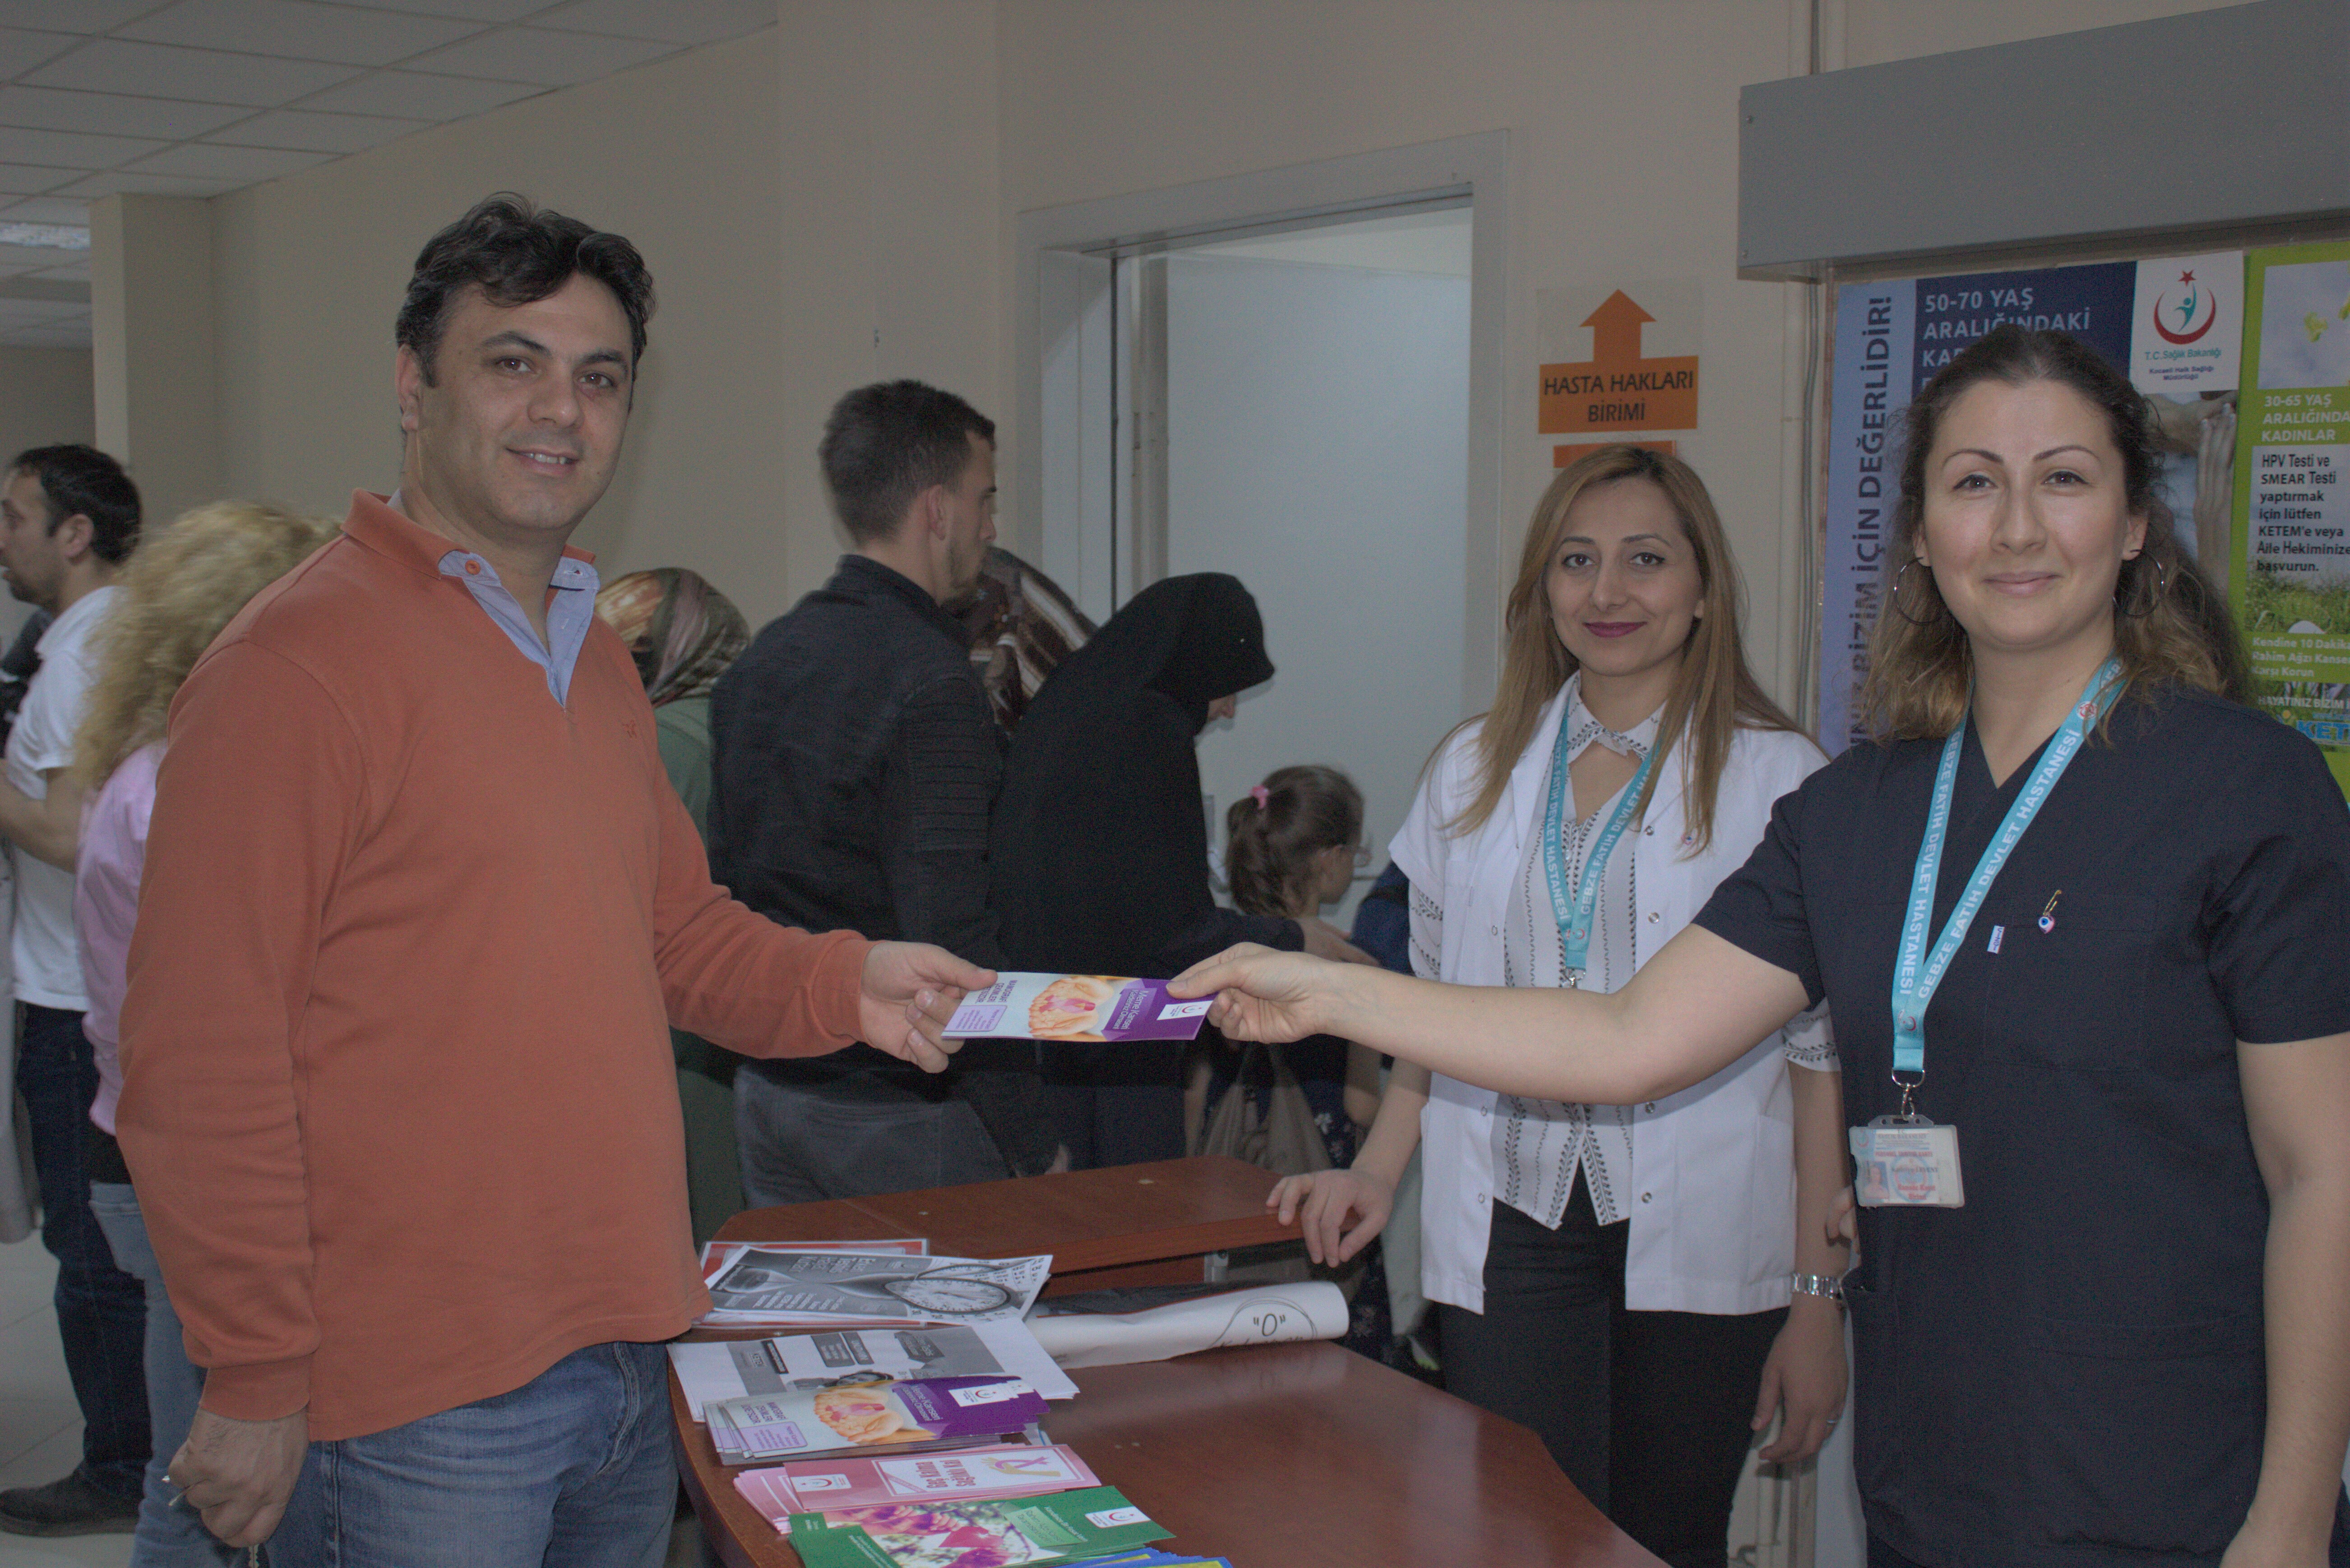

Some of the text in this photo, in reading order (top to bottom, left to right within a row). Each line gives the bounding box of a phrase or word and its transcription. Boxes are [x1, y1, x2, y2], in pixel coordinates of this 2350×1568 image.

[1924, 287, 2035, 313] 50-70 YAŞ
[1543, 370, 1694, 395] HASTA HAKLARI
[1856, 296, 1892, 498] DEĞERLİDİR!
[2264, 393, 2332, 408] 30-65 YAŞ
[1587, 398, 1646, 423] BİRİMİ
[2261, 429, 2336, 442] KADINLAR
[2262, 453, 2330, 468] HPV Testi ve
[2261, 470, 2336, 485] SMEAR Testi
[2259, 489, 2324, 505] yaptırmak
[2258, 507, 2322, 522] için lütfen
[1850, 507, 1885, 572] İÇİN
[2258, 526, 2344, 540] KETEM'e veya
[2256, 540, 2281, 554] Aile
[2256, 559, 2319, 574] başvurun.
[2252, 636, 2298, 648] Kendine
[2300, 638, 2314, 649] 10
[2252, 650, 2286, 662] Rahim
[2287, 652, 2313, 664] Ağzı
[2281, 666, 2315, 677] Korun
[2257, 696, 2312, 707] HAYATINIZ
[2296, 720, 2350, 740] KET
[1940, 731, 1961, 782] GEBZE
[1550, 770, 1561, 801] FATİH
[1931, 783, 1949, 830] FATİH
[1547, 804, 1559, 842] DEVLET
[1580, 791, 1641, 915] GEBZE FATİH DEVLET
[1917, 832, 1940, 894] DEVLET
[1917, 727, 2082, 999] GEBZE FATİH DEVLET HASTANESİ
[1120, 990, 1149, 1029] Meme Kanseri
[921, 1399, 943, 1420] Kanseri
